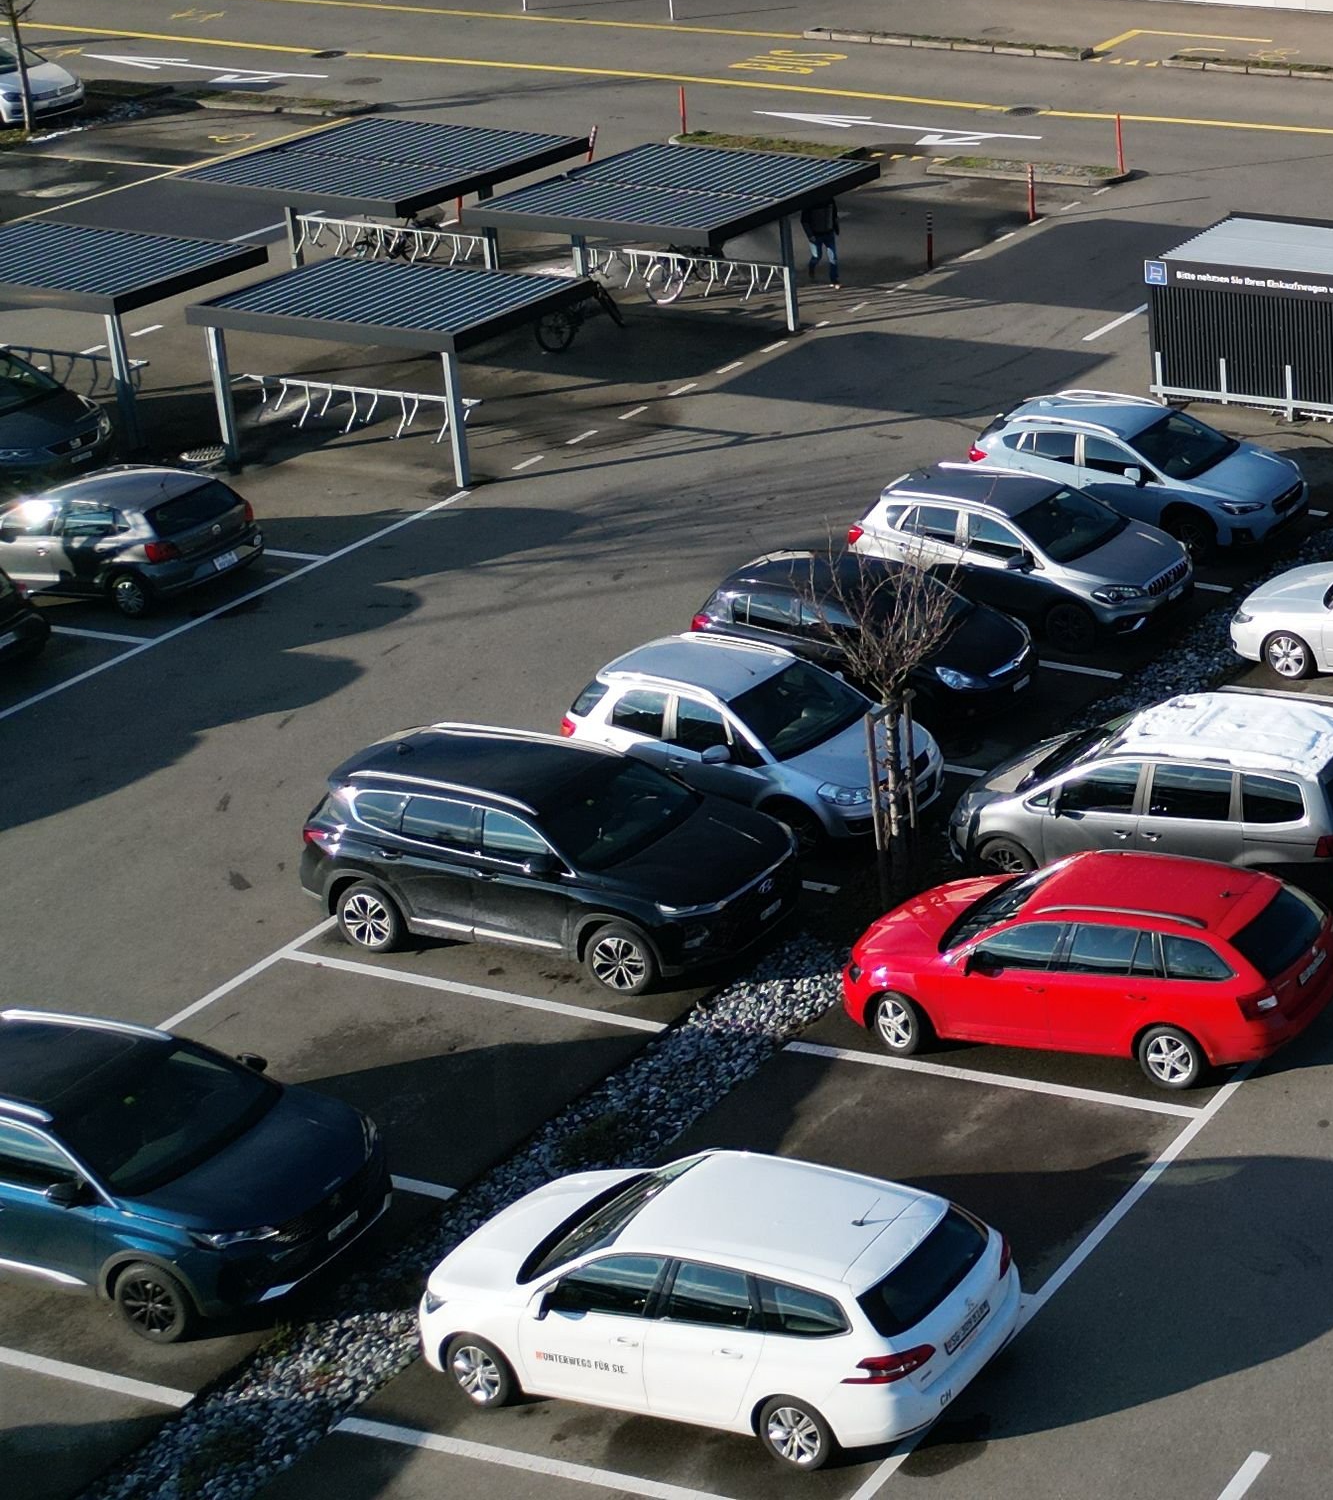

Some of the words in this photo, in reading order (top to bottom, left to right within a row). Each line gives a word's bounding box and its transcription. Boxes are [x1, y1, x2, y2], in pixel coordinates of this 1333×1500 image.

[728, 49, 848, 75] BUS
[1176, 270, 1196, 280] Bitte
[1197, 273, 1230, 284] nehmen
[1231, 275, 1243, 285] Sie
[1267, 279, 1328, 294] Einkaufswagen
[594, 1359, 610, 1372] FÜR
[940, 1389, 952, 1406] CH
